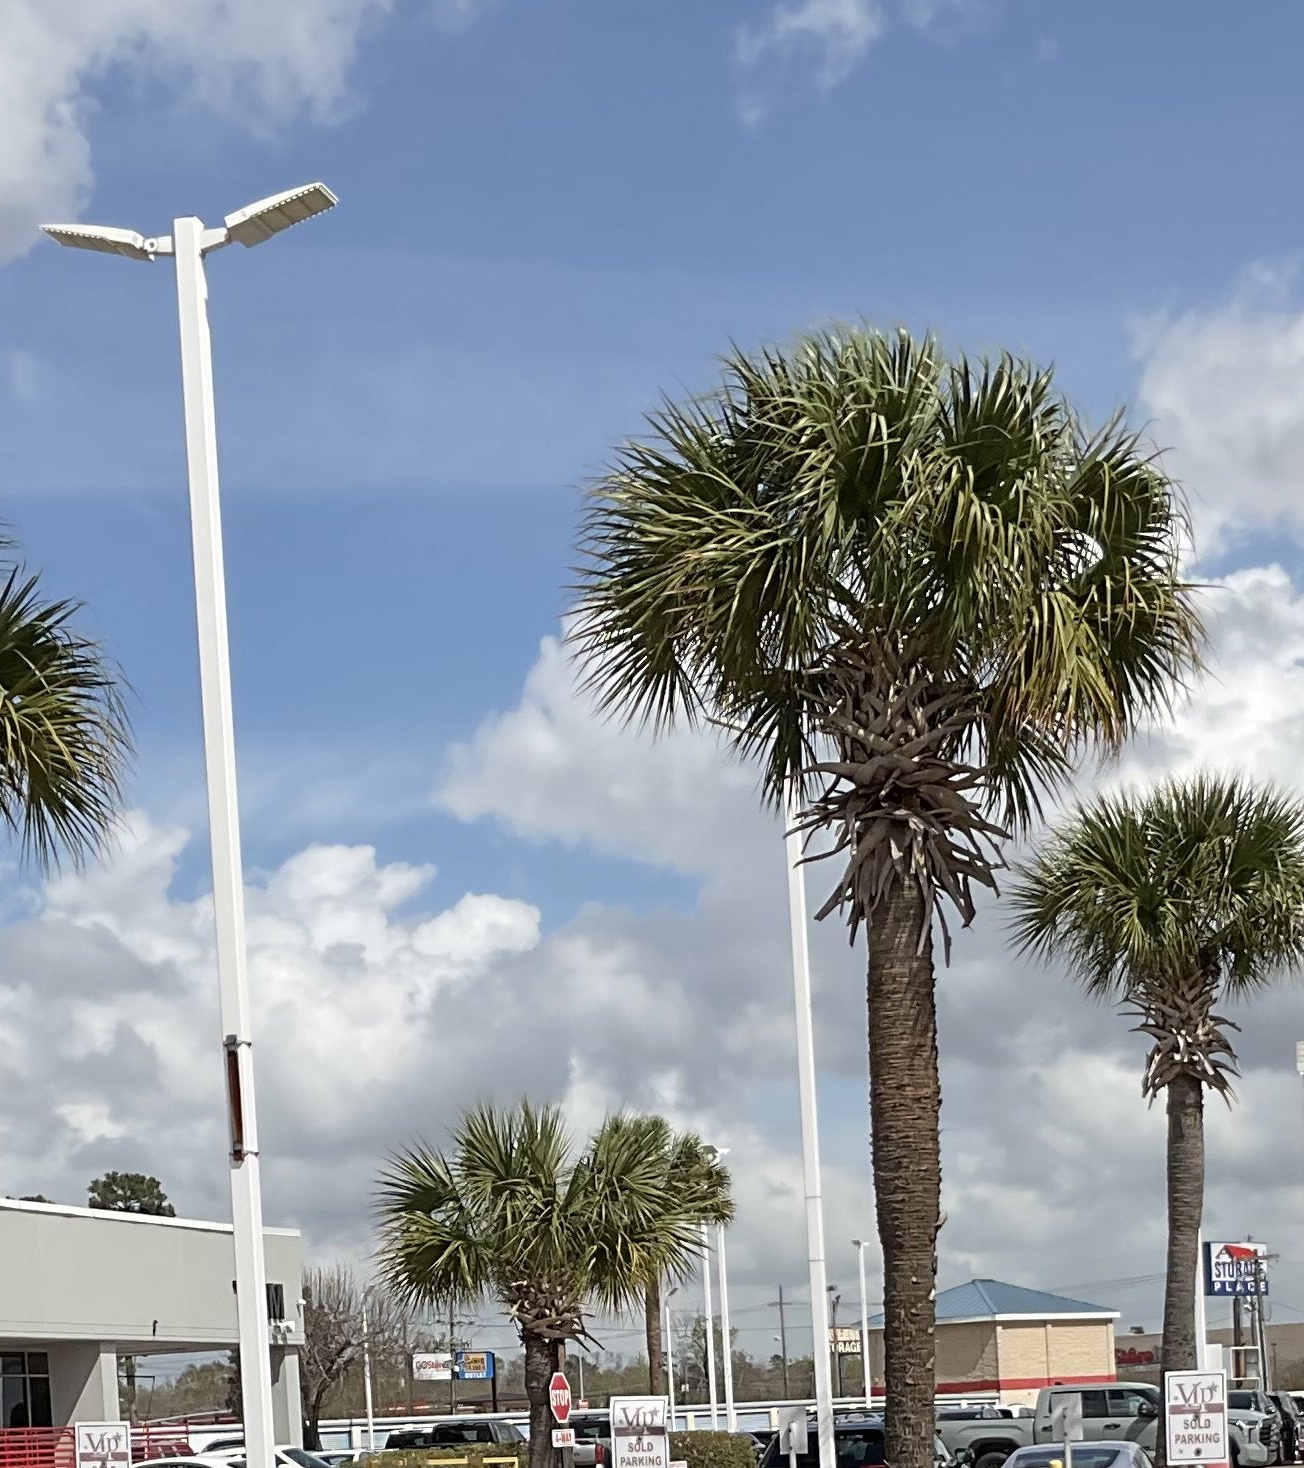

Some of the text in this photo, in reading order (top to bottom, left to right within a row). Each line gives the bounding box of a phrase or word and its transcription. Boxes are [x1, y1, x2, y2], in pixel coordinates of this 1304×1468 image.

[1214, 1282, 1267, 1292] PLACE
[552, 1389, 569, 1406] STOP
[1183, 1419, 1211, 1429] SOLD
[1175, 1433, 1221, 1445] PARKING
[628, 1442, 654, 1453] SOLD
[620, 1456, 662, 1467] PARKING
